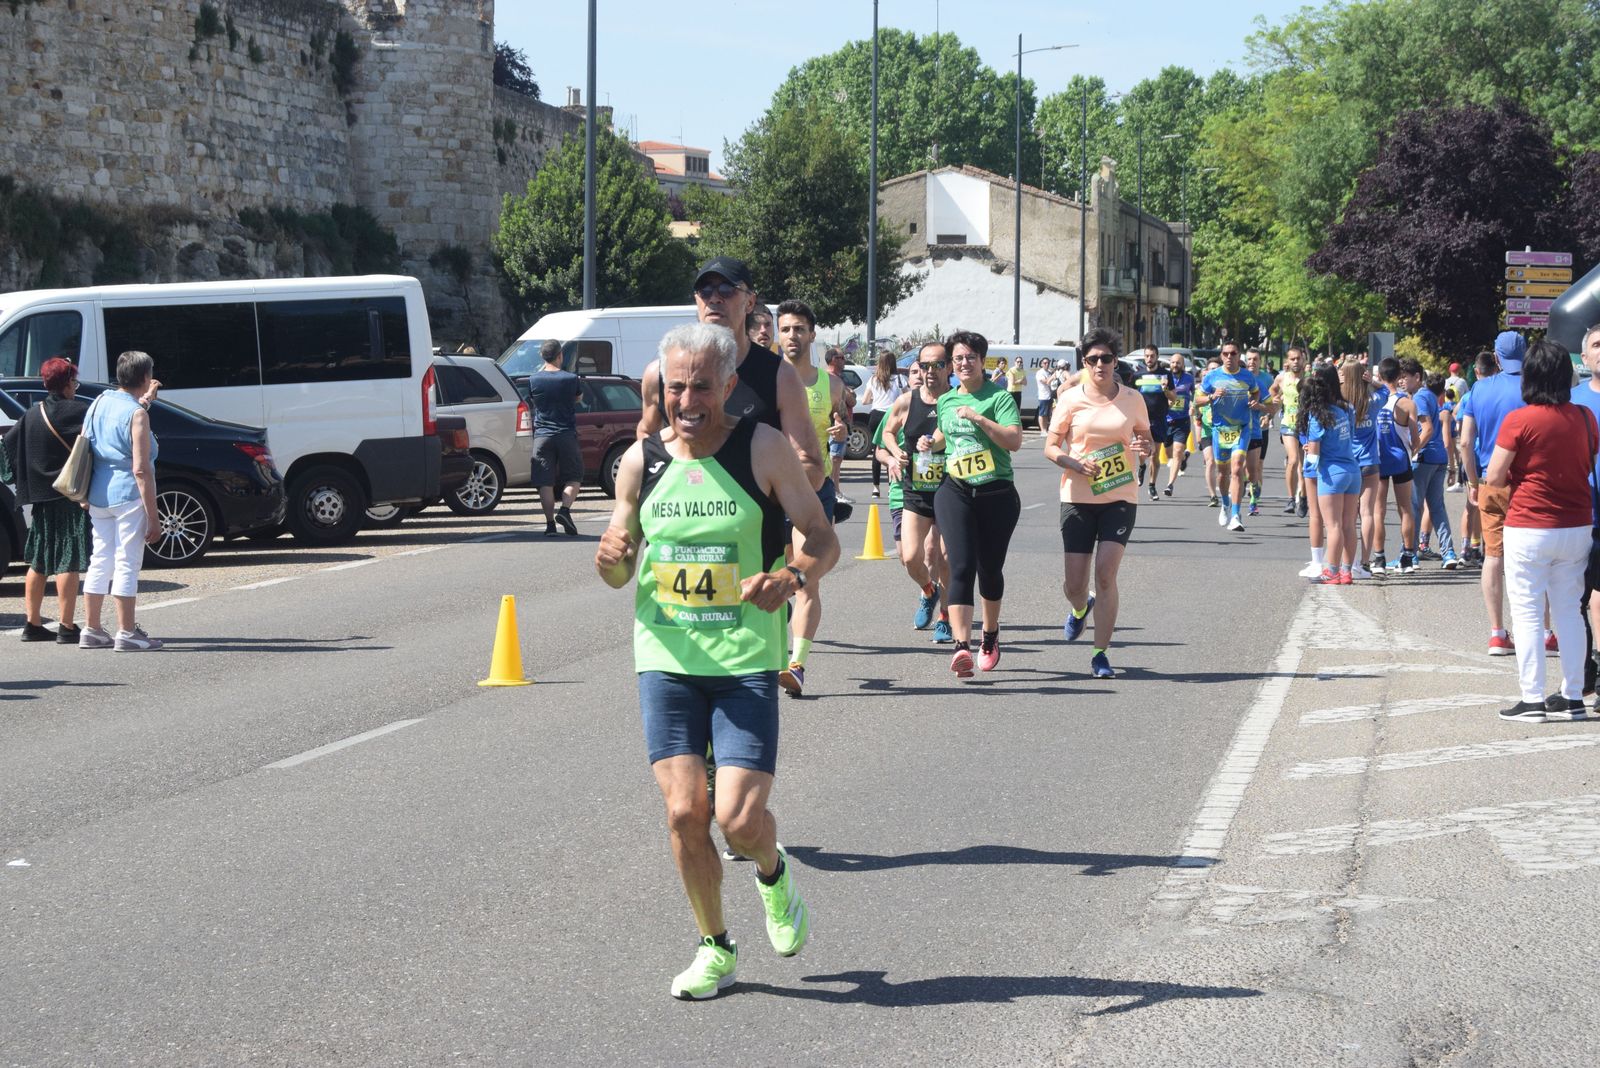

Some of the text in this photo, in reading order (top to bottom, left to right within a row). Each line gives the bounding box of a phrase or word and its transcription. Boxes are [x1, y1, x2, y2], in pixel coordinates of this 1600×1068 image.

[1224, 432, 1237, 441] 85
[953, 454, 987, 476] 175
[651, 500, 737, 518] MESA VALORIO
[674, 554, 726, 562] CAJA RURAL
[673, 568, 717, 601] 44
[678, 611, 737, 622] CAJA RURAL
